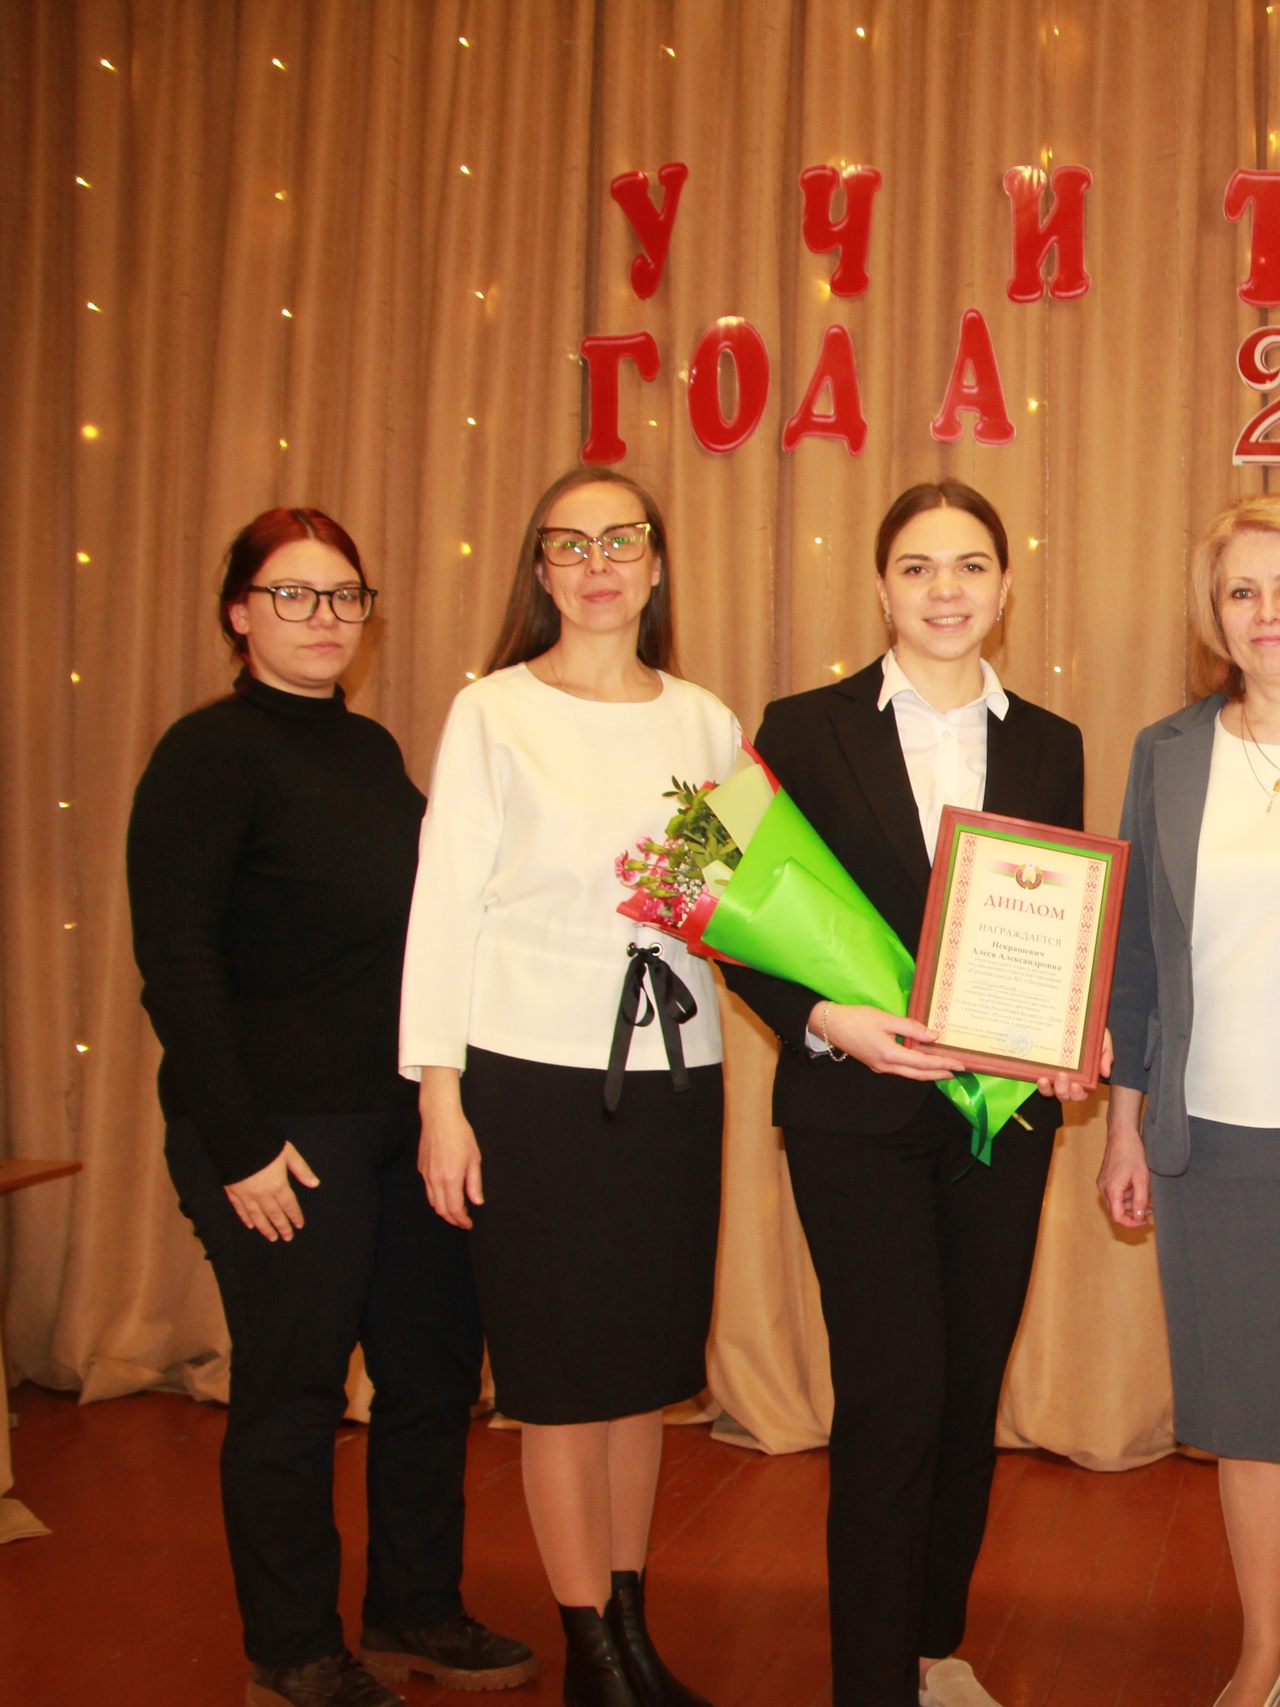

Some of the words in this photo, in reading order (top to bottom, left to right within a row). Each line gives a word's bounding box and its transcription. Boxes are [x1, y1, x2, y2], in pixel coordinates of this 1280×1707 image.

[579, 308, 1017, 465] ГОДА
[984, 894, 1065, 920] ДИПЛОМ
[978, 923, 1062, 947] НАГРАЖДАЕТСЯ
[971, 947, 997, 958] Алеся
[998, 952, 1062, 972] Александровна
[992, 940, 1045, 958] Некрашевич
